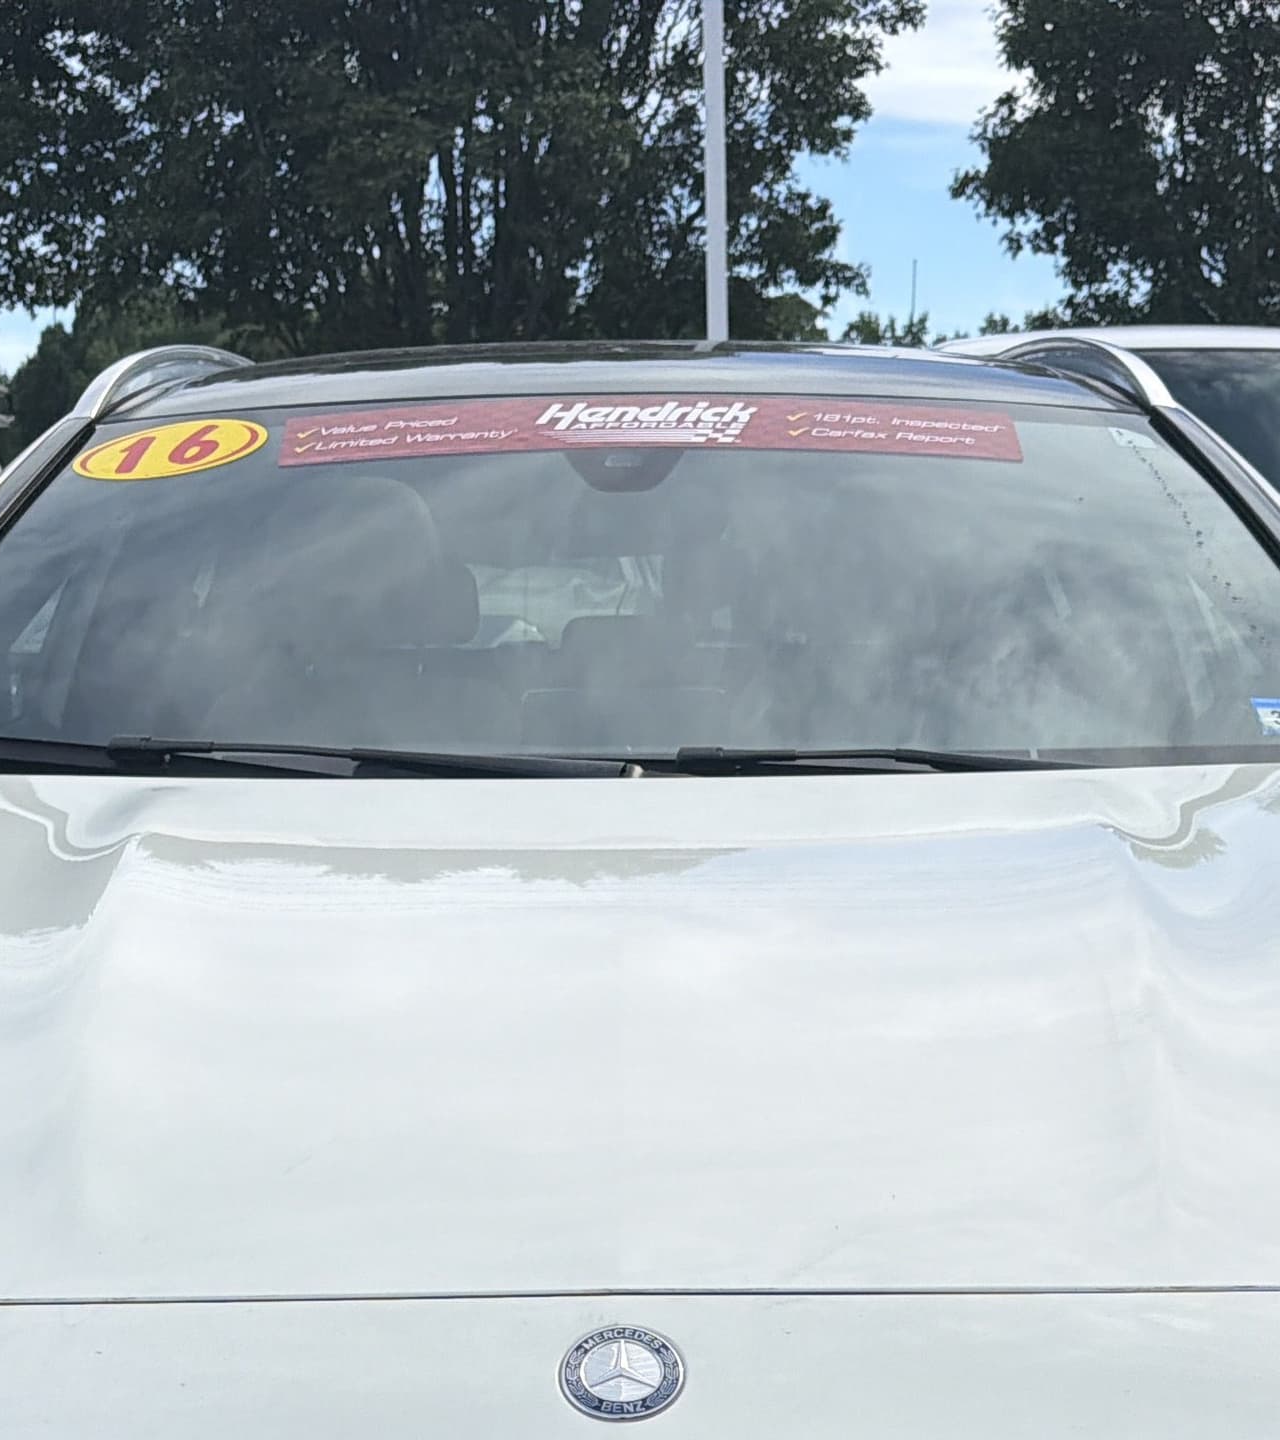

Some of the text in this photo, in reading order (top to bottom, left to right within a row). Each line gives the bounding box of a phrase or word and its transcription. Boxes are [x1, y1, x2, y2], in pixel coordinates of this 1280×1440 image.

[535, 402, 759, 430] Hendrick
[321, 416, 458, 436] Value Priced
[571, 422, 745, 430] AFFORDABLE
[315, 436, 399, 451] Limited
[811, 427, 977, 445] Carfax Report
[115, 424, 219, 475] 16
[581, 1328, 662, 1350] MERCEDES
[601, 1401, 646, 1413] BENZ
